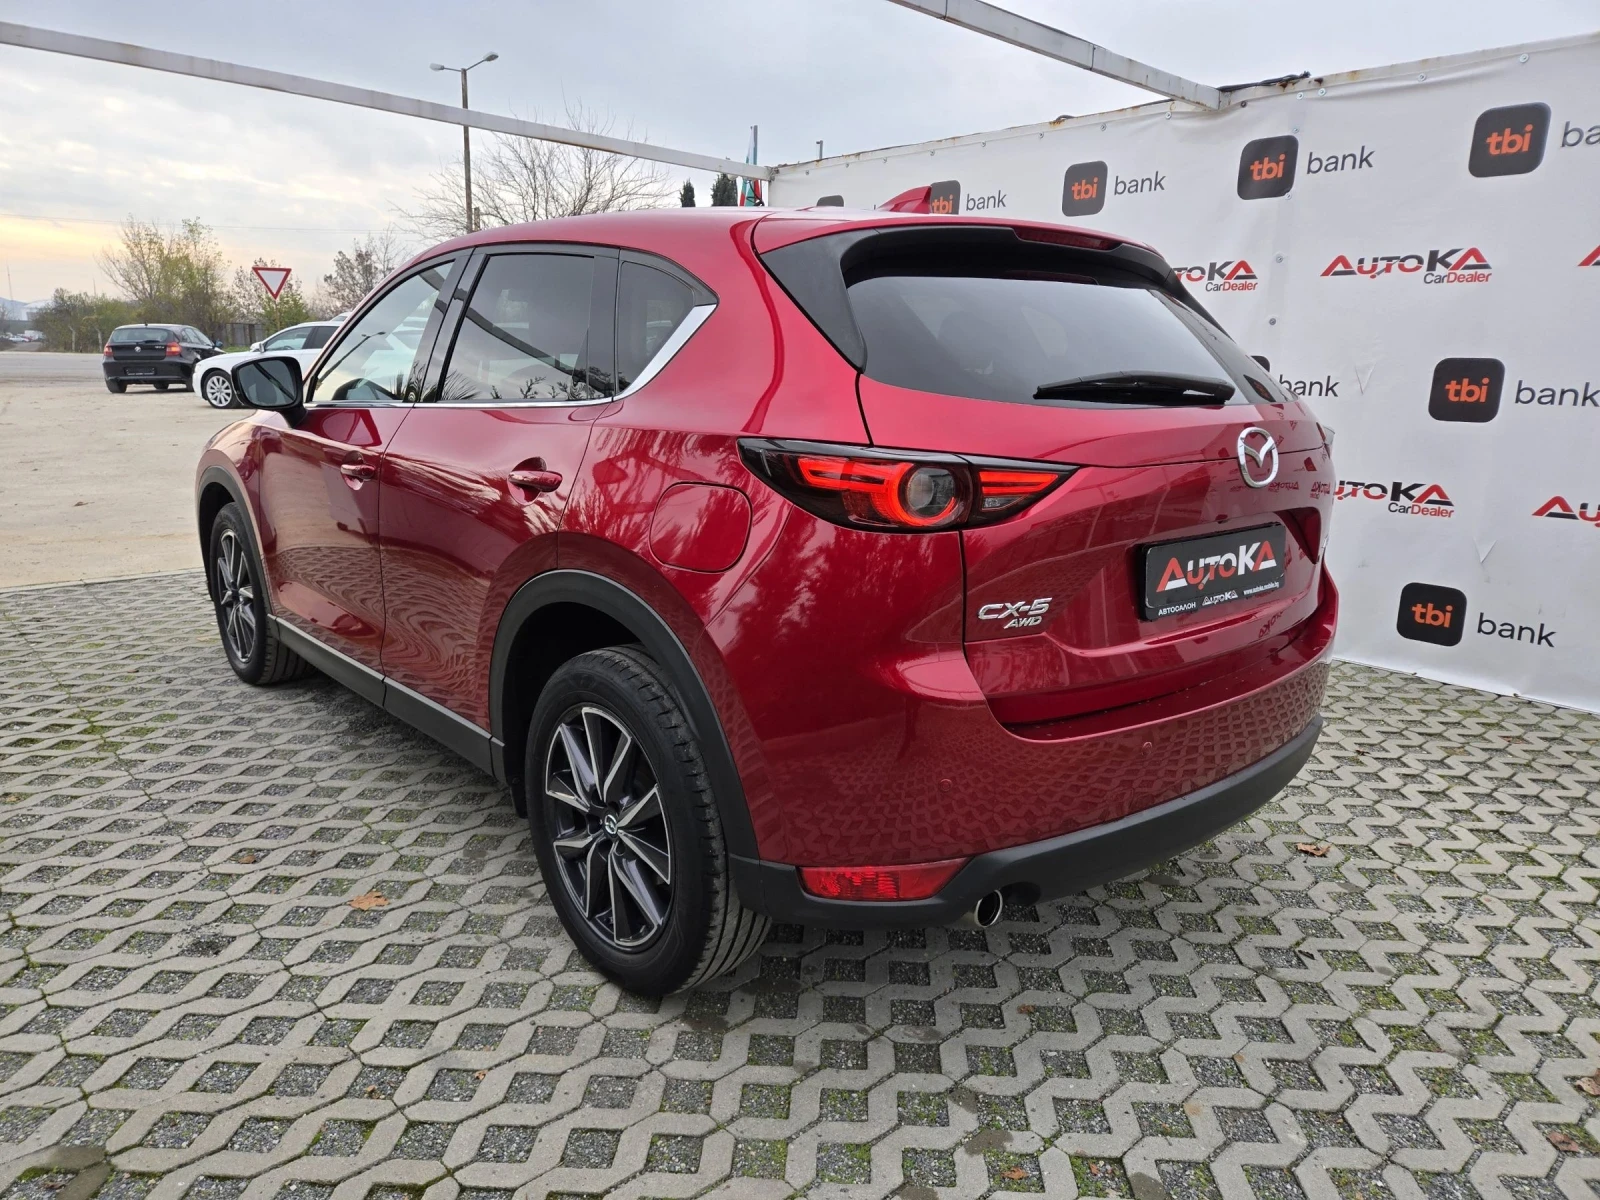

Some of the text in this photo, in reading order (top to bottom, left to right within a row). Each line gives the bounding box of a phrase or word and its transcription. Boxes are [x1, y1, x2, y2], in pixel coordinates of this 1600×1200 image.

[1486, 124, 1534, 155] tbi
[1250, 145, 1376, 181] tbi bank
[1071, 170, 1166, 200] tbi bank
[931, 189, 1007, 214] tbi bank
[1205, 281, 1258, 292] CarDealer
[1423, 270, 1492, 285] CarDealer
[1445, 377, 1600, 407] tbi bank
[1387, 502, 1454, 518] CarDealer
[1156, 540, 1277, 590] AUTOKA
[978, 597, 1053, 620] CX-5
[1158, 601, 1197, 616] АВТОСАЛОН
[1003, 615, 1043, 629] AWD
[1411, 602, 1557, 648] tbi bank
